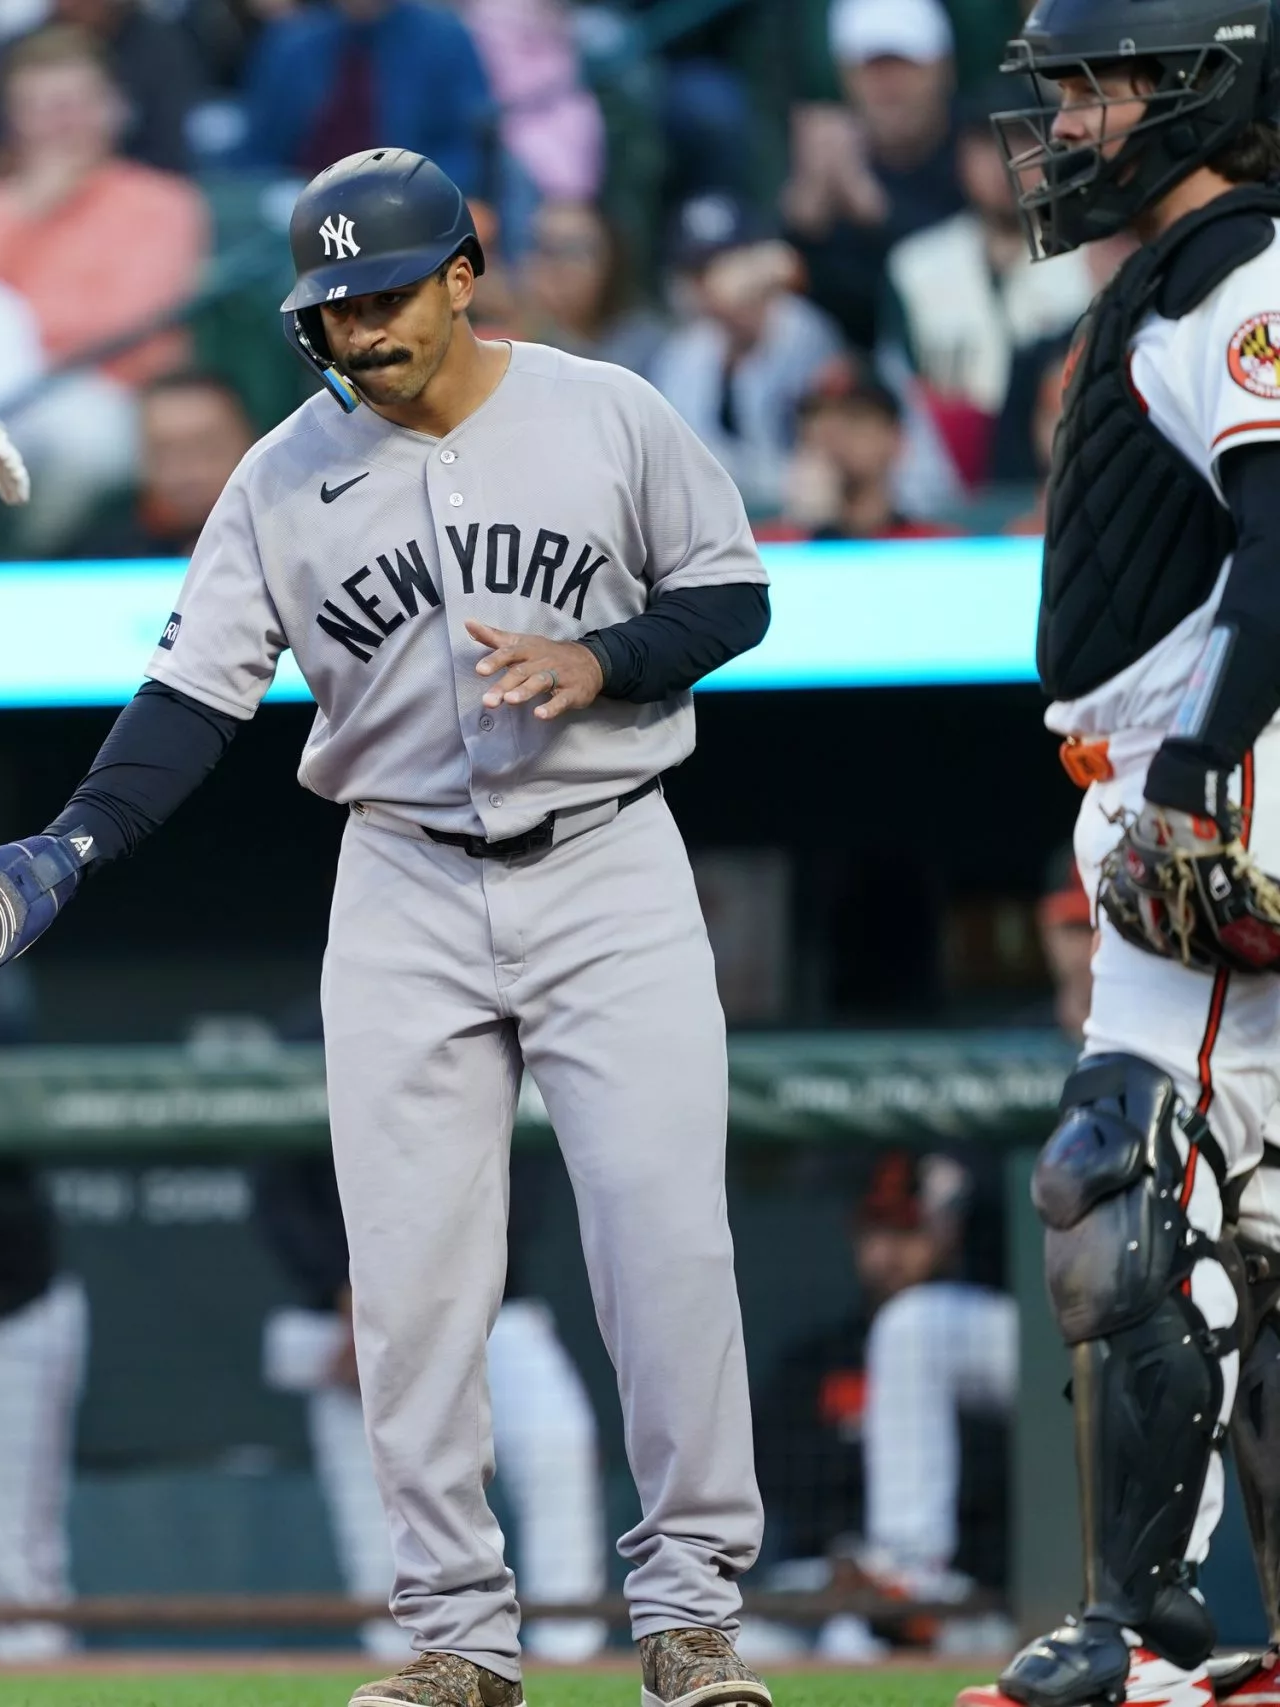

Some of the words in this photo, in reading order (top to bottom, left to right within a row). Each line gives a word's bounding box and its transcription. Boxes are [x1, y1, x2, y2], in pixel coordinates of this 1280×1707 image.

[318, 213, 361, 260] NY
[317, 540, 440, 663] NEW
[446, 522, 609, 620] YORK
